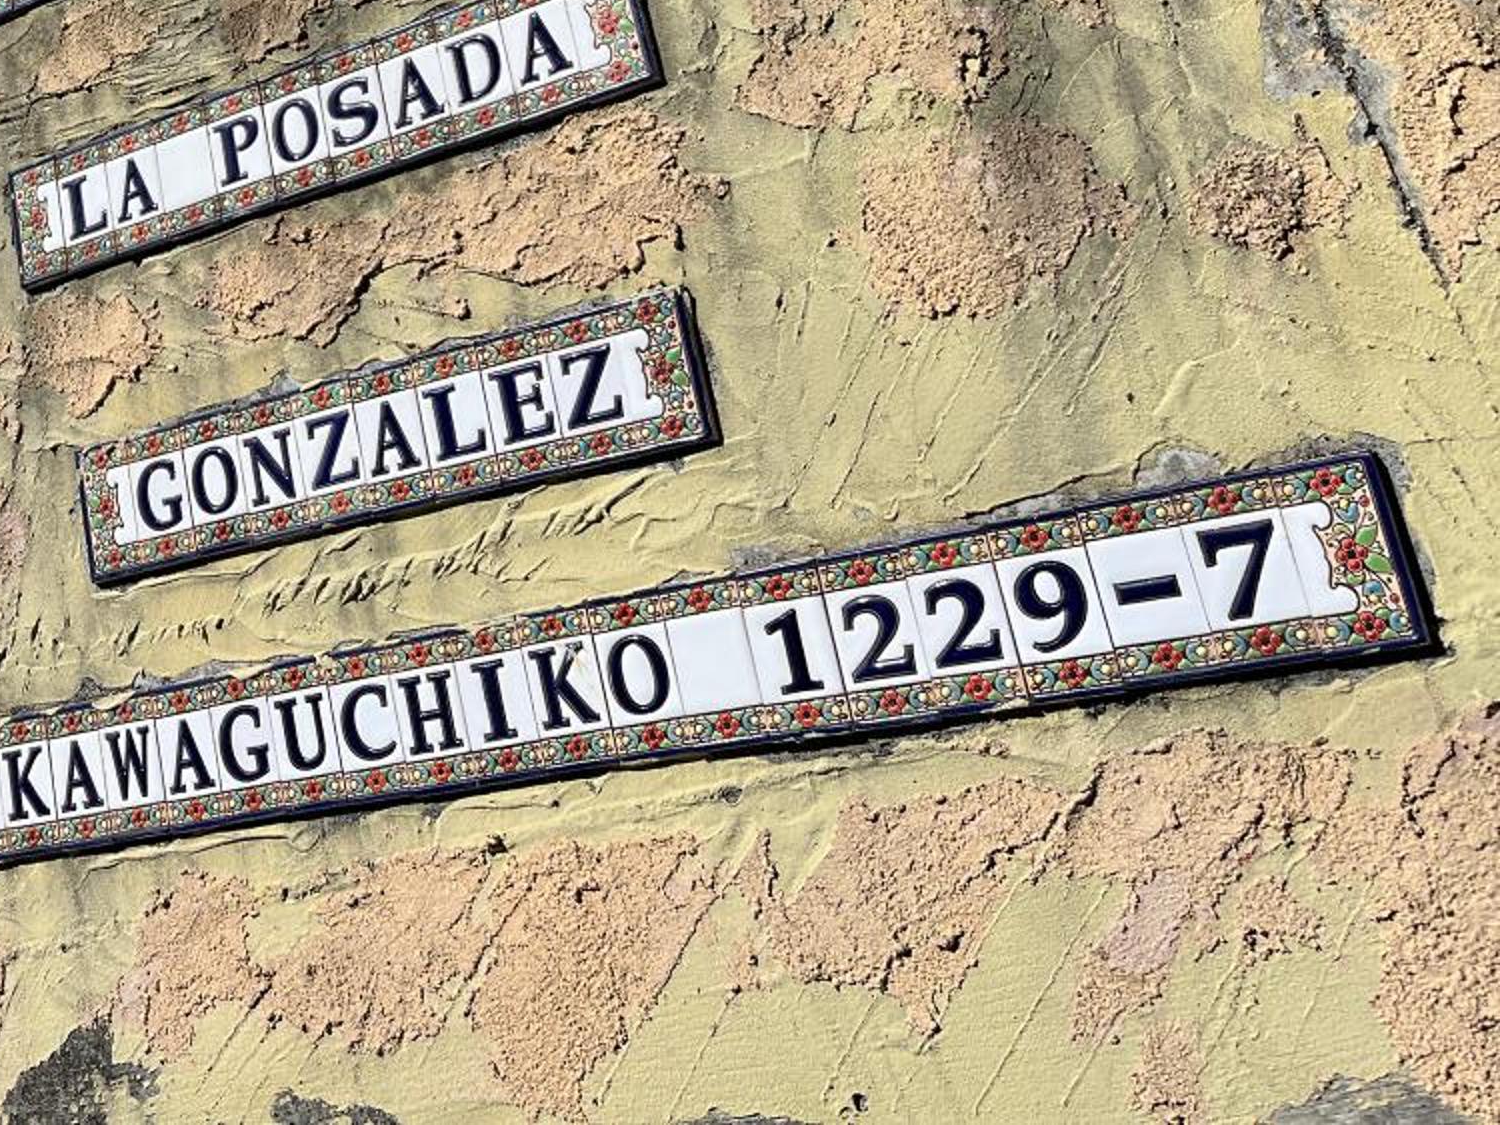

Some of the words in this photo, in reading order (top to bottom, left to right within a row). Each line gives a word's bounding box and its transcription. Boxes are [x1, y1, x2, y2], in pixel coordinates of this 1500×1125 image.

[62, 159, 158, 242] LA
[216, 12, 573, 187] POSADA
[136, 342, 625, 531] GONZALEZ
[0, 631, 671, 824] KAWAGUCHIKO
[764, 517, 1278, 697] 1229-7
